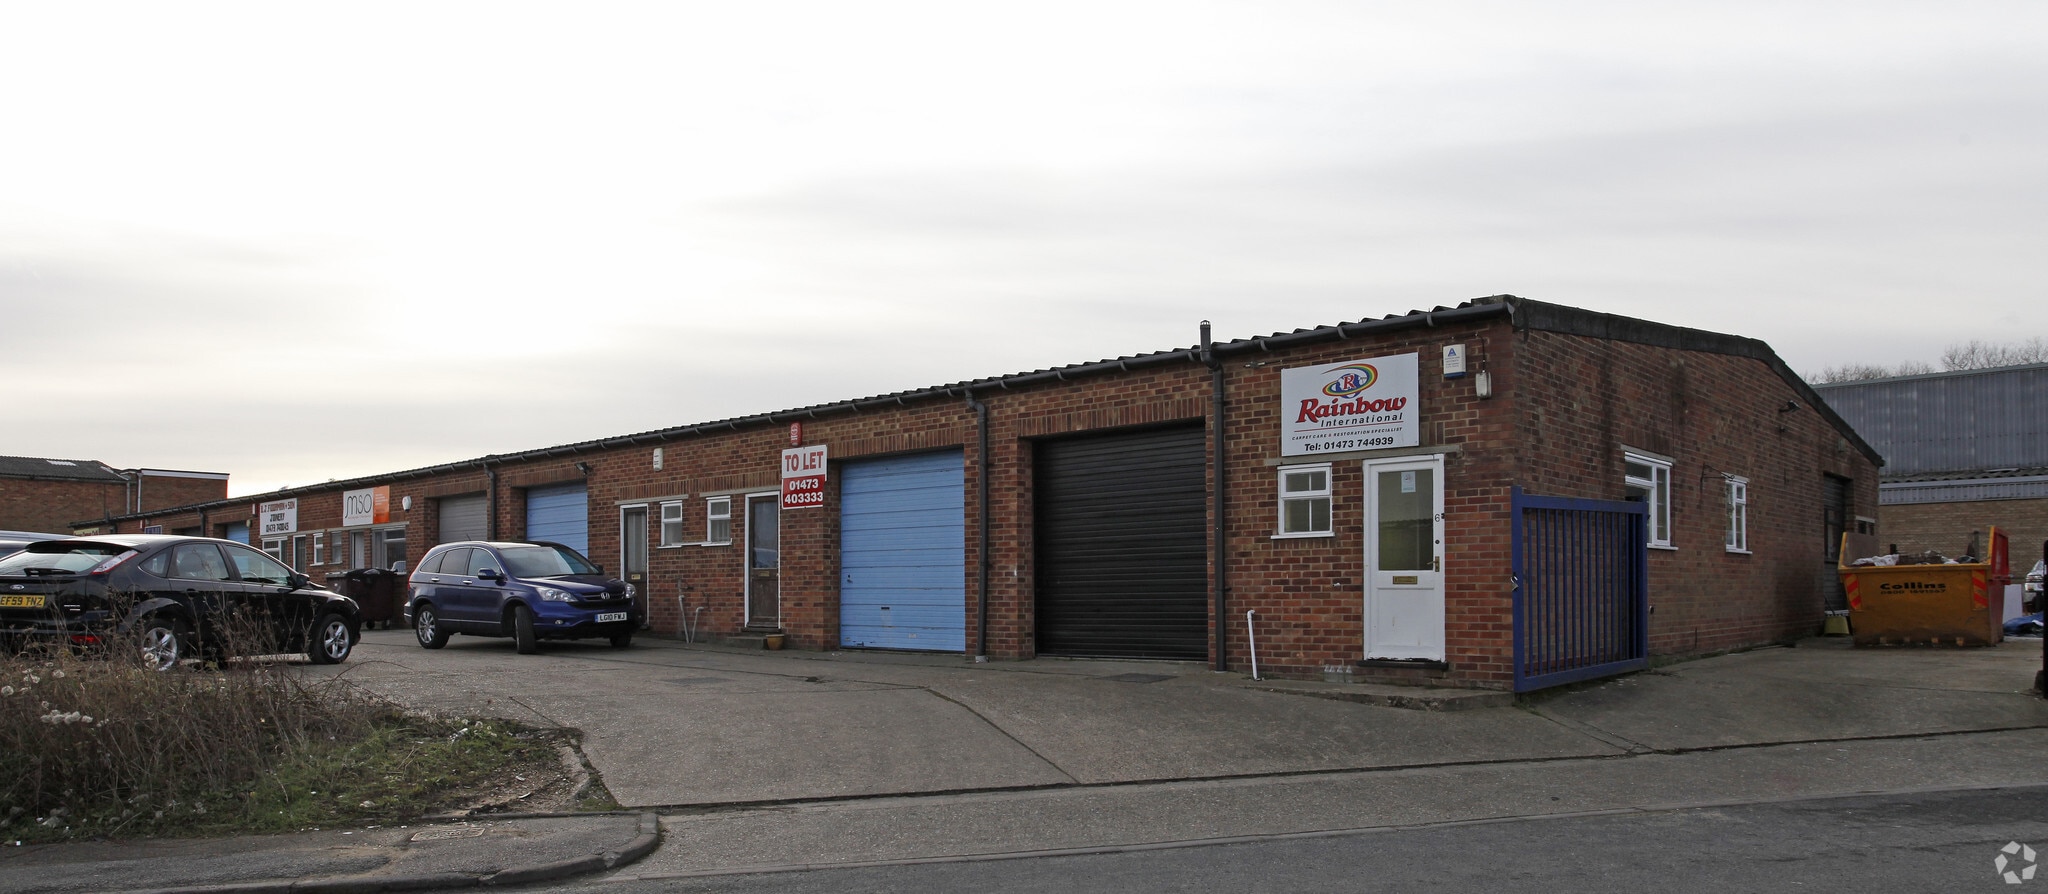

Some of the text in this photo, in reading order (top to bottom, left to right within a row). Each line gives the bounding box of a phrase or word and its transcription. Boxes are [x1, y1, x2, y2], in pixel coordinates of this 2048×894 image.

[1343, 374, 1357, 390] R
[1295, 396, 1407, 424] Rainbow
[1320, 412, 1403, 428] International
[1333, 429, 1370, 437] RESTORATION
[1304, 436, 1394, 451] Tel: 01473 744939
[785, 450, 824, 472] TO LET
[789, 478, 819, 490] 01473
[785, 491, 823, 504] 403333
[1435, 513, 1441, 523] 6
[1880, 581, 1947, 590] Collins
[0, 596, 43, 606] EF59 TNZ
